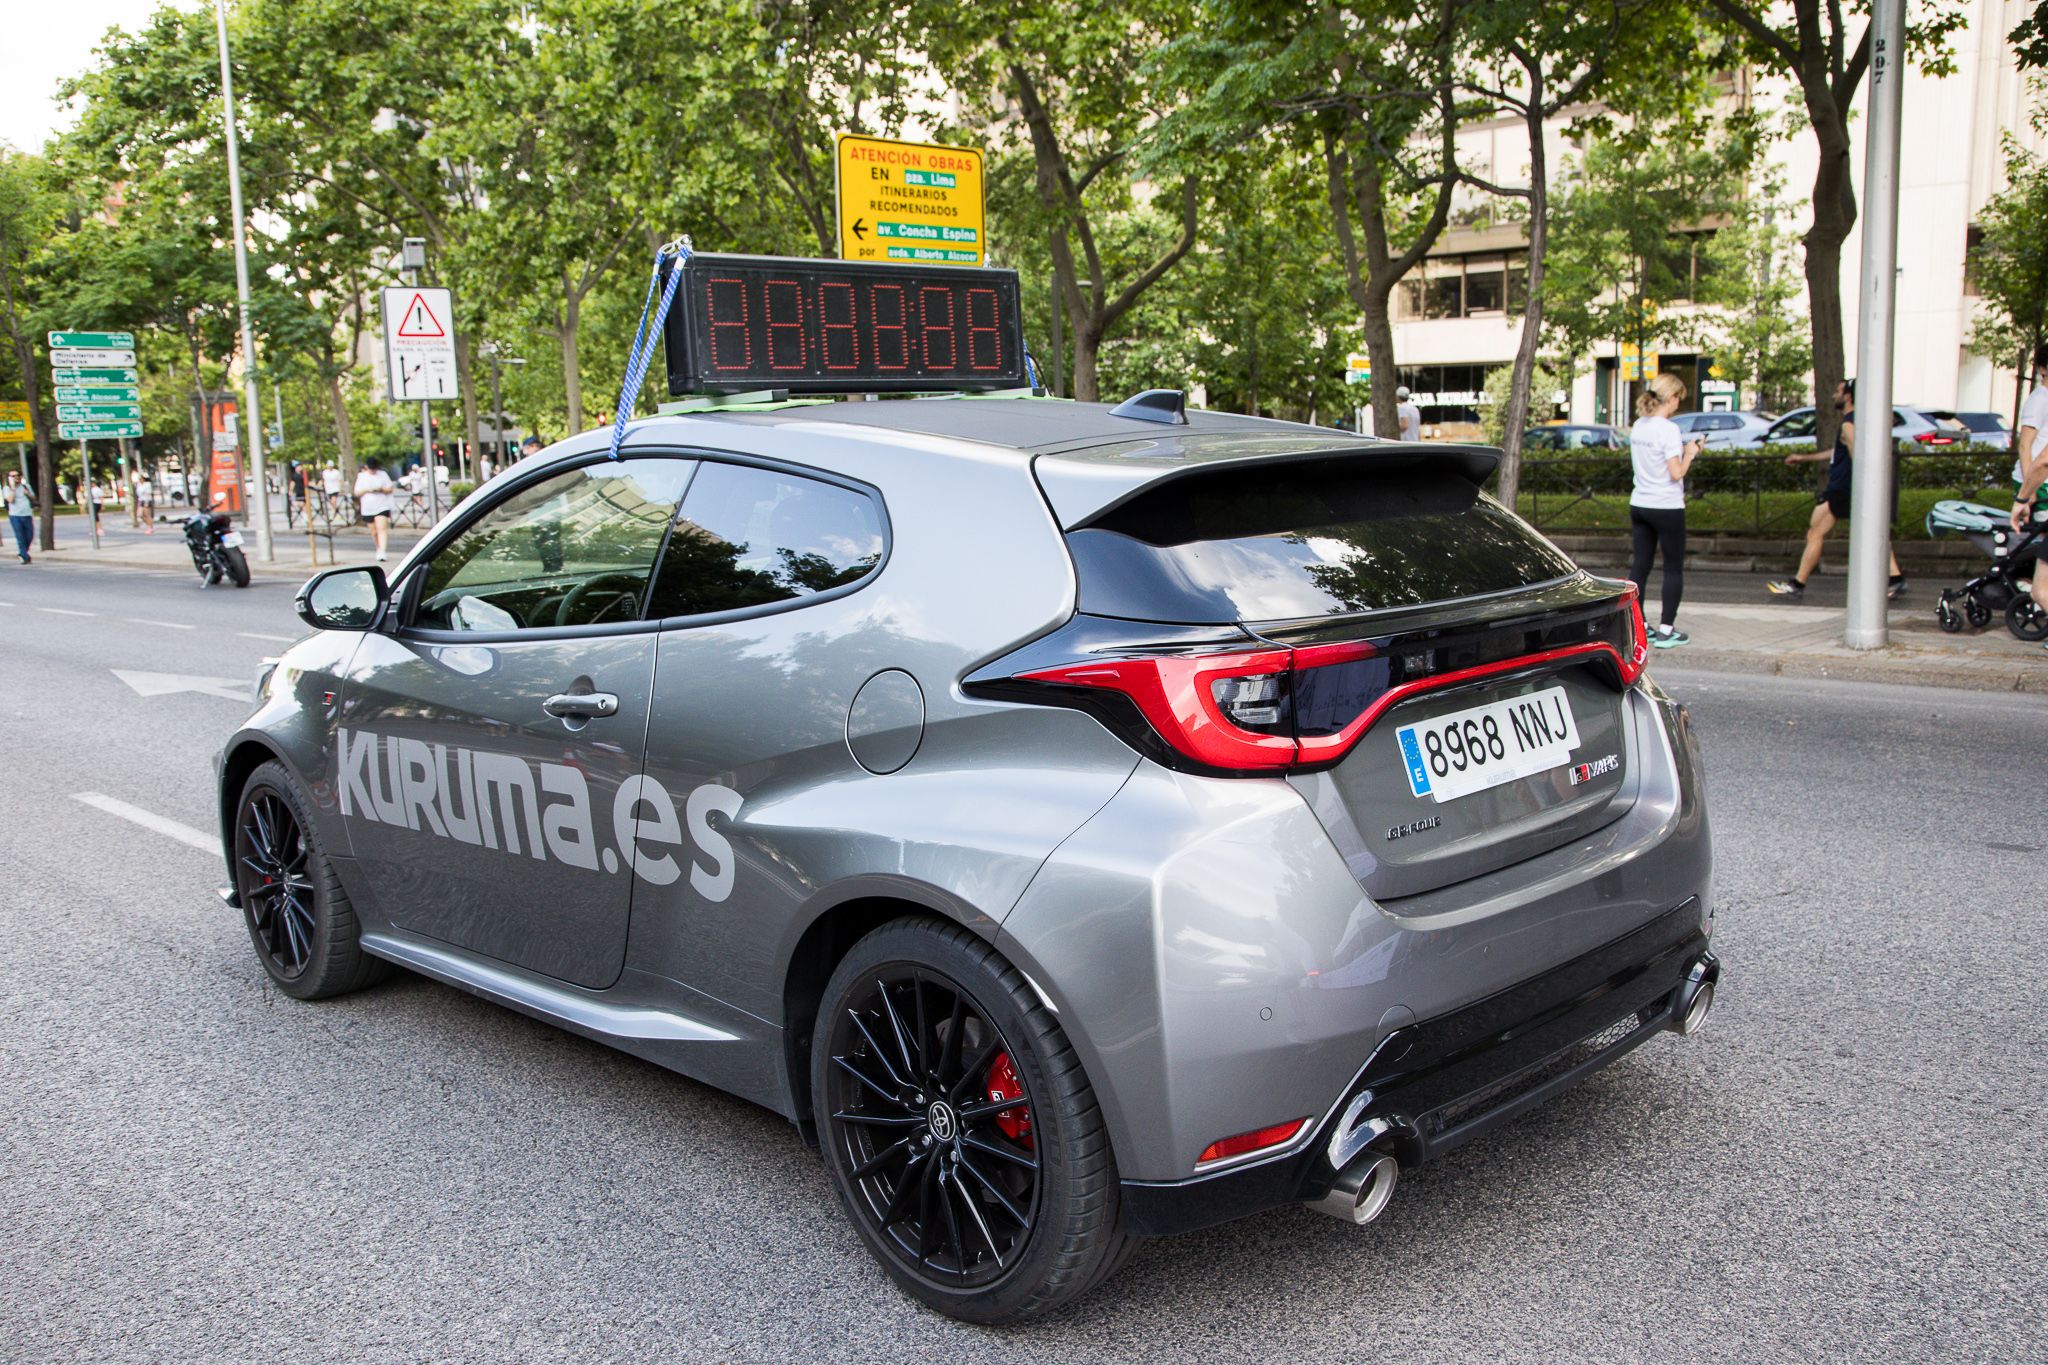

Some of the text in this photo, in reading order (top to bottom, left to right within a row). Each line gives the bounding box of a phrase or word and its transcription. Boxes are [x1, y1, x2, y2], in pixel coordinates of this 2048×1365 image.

[850, 147, 973, 171] ATENCIÓN OBRAS
[871, 167, 956, 186] EN pza. Lima
[880, 186, 947, 200] ITINERARIOS
[870, 200, 958, 216] RECOMENDADOS
[878, 224, 977, 241] av. Concha Espina
[859, 247, 875, 257] por
[914, 249, 944, 260] Alberto
[948, 251, 977, 262] Alcocer
[1424, 695, 1568, 778] 8968 NNJ
[1413, 766, 1424, 783] E
